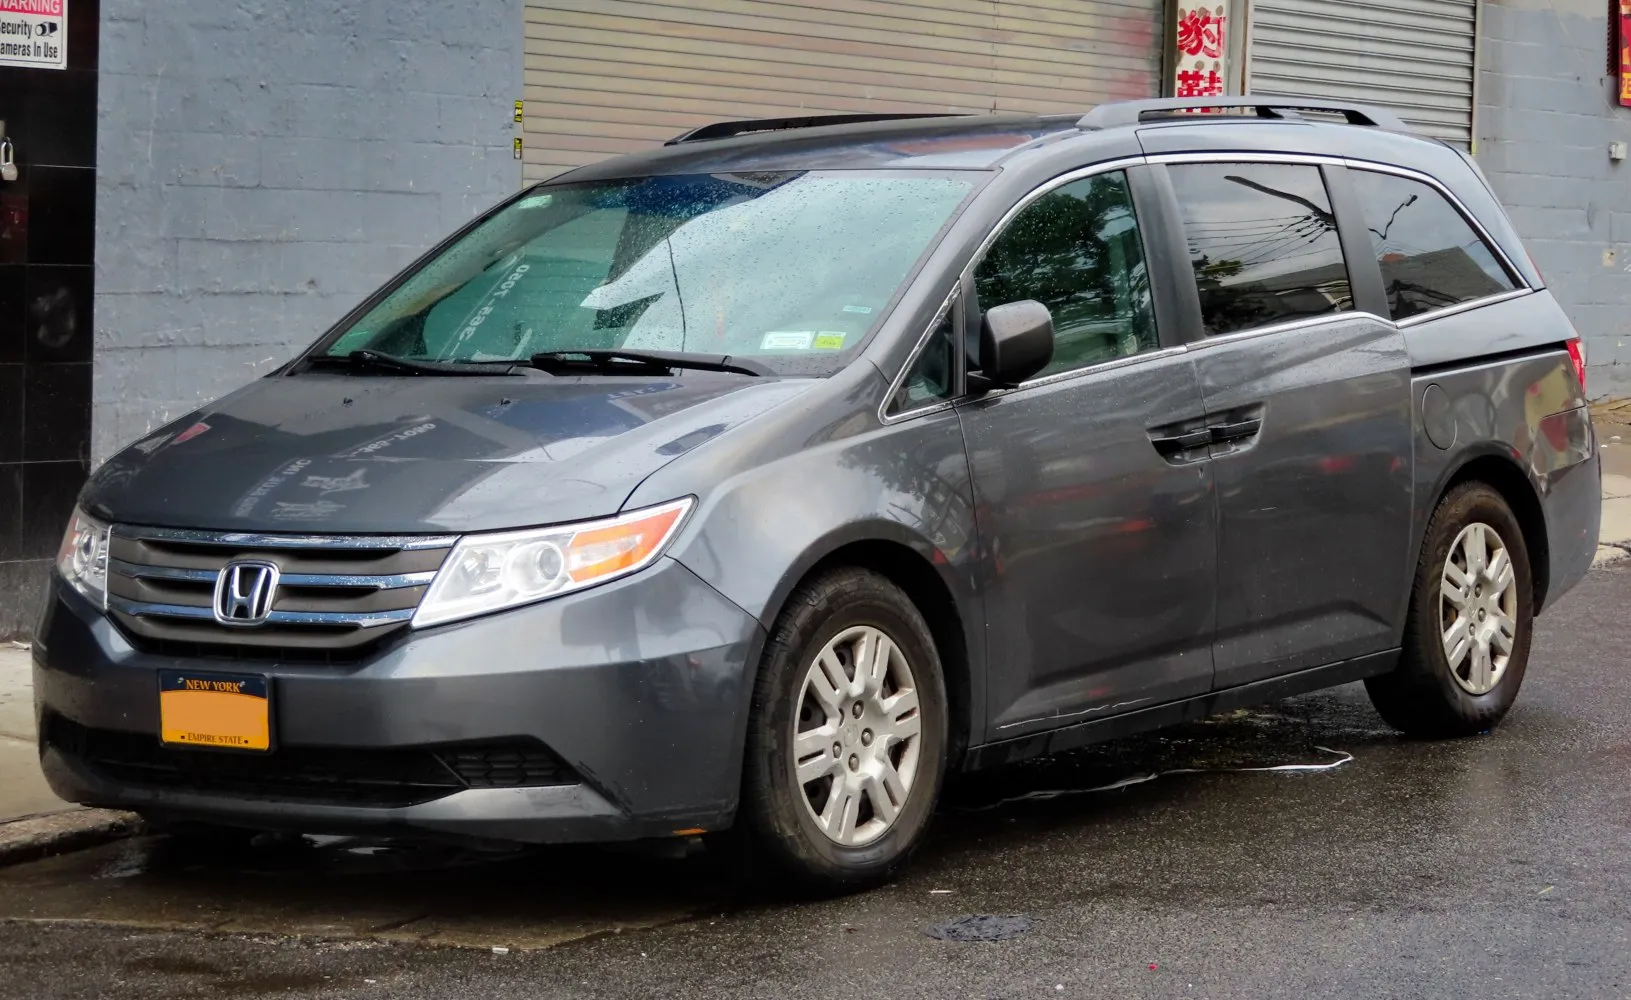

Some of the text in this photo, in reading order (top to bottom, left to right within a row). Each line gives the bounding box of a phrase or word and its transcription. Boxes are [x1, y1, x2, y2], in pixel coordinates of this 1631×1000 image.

[0, 18, 33, 39] ecurity
[0, 41, 58, 58] ameras In Use
[185, 679, 241, 693] NEW YORK
[187, 732, 244, 745] EMPIRE STATE
